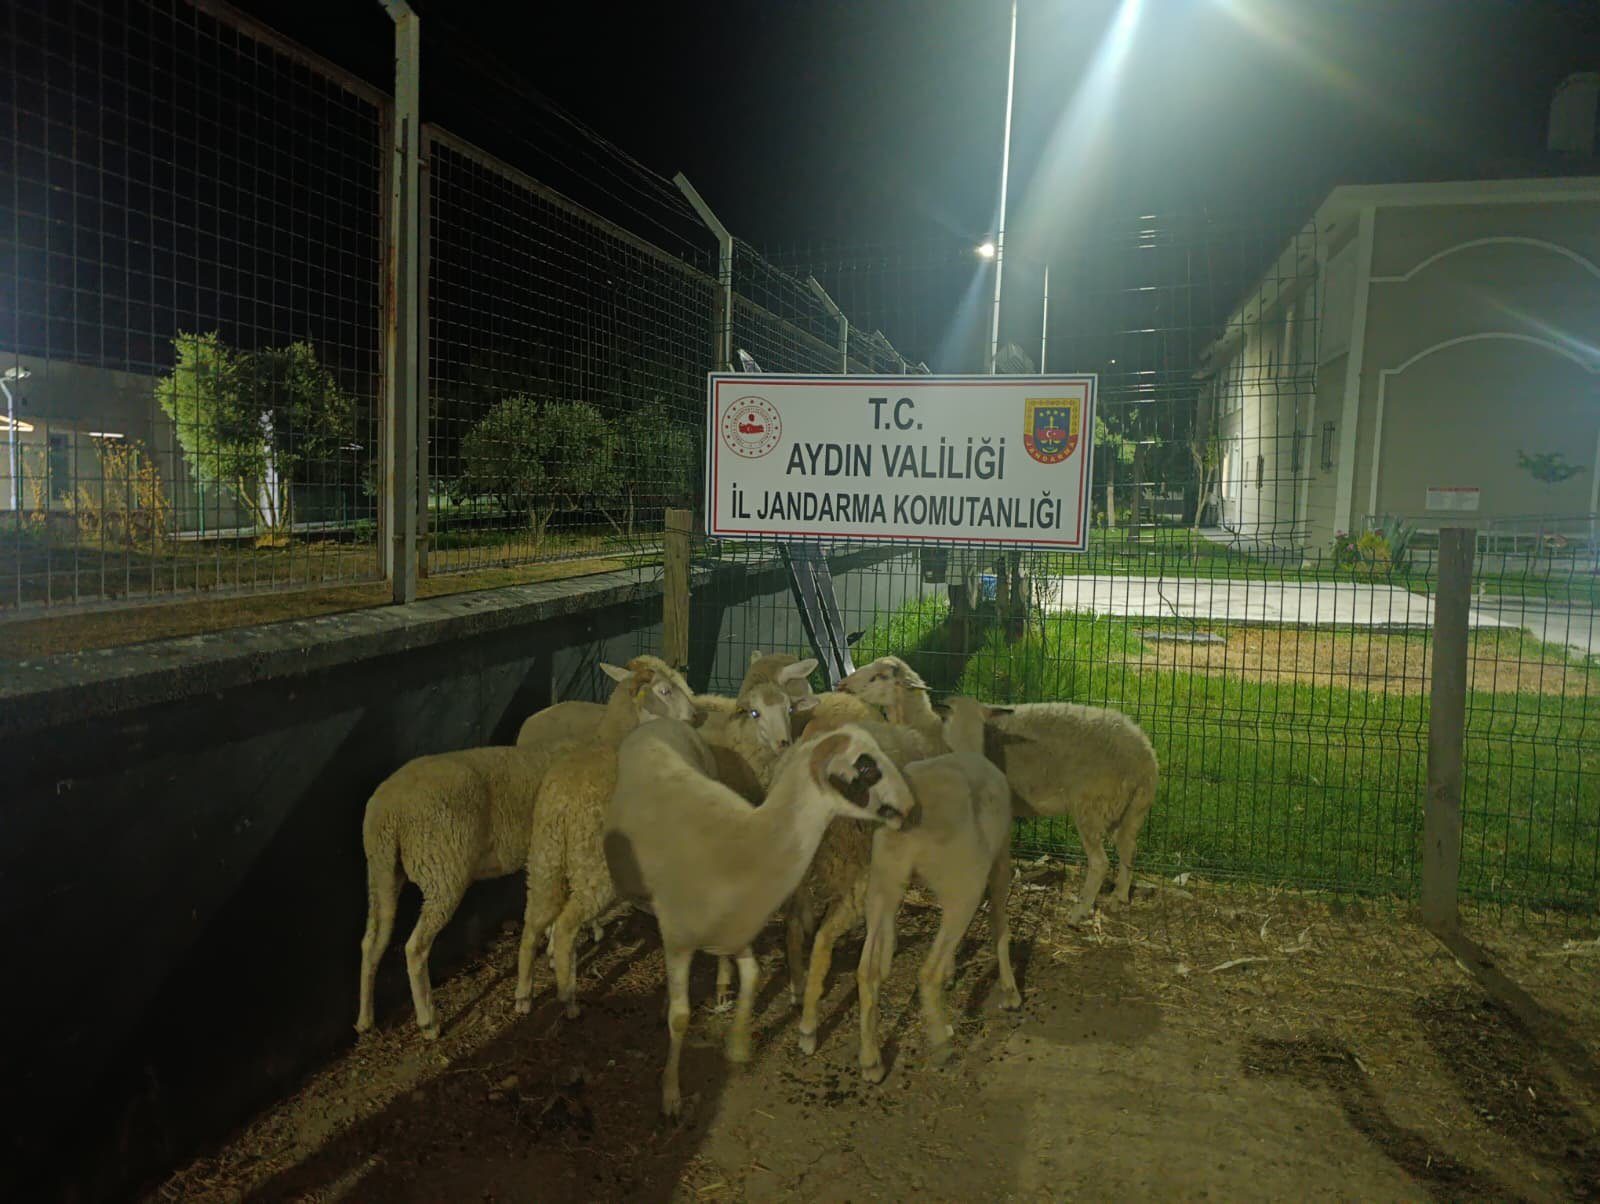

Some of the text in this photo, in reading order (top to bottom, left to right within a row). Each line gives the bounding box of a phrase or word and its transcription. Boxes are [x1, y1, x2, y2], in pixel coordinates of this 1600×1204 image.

[868, 397, 923, 431] T.C.
[786, 436, 1006, 480] AYDIN VALİLİĞİ
[732, 483, 1062, 530] İL JANDARMA KOMUTANLIĞI
